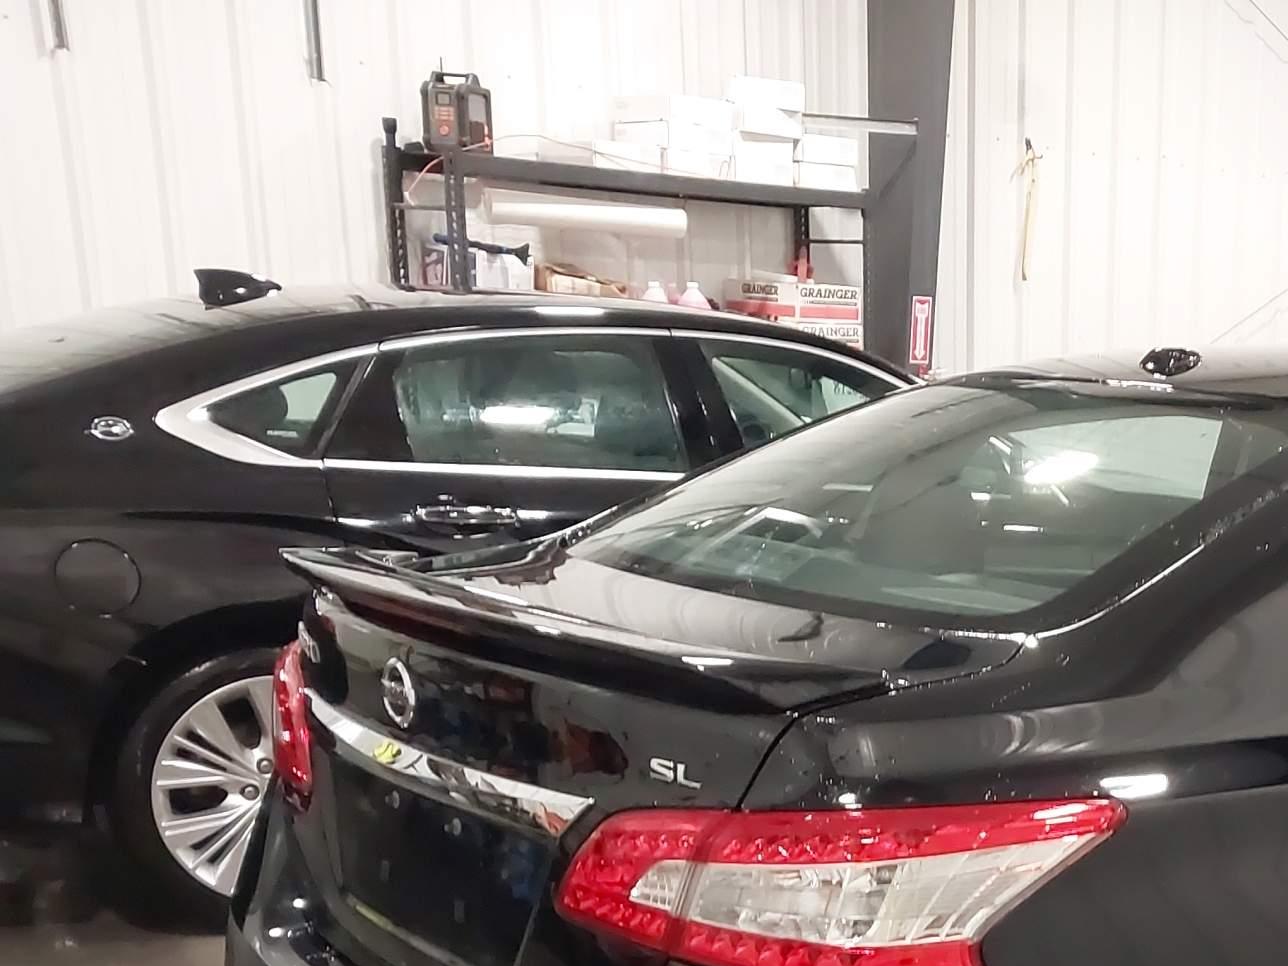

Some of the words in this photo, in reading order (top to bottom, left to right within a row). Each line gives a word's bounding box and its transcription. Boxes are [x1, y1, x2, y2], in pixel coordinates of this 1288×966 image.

[741, 282, 779, 296] GRAINGER
[799, 287, 858, 300] GRAINGER
[650, 757, 703, 790] SL
